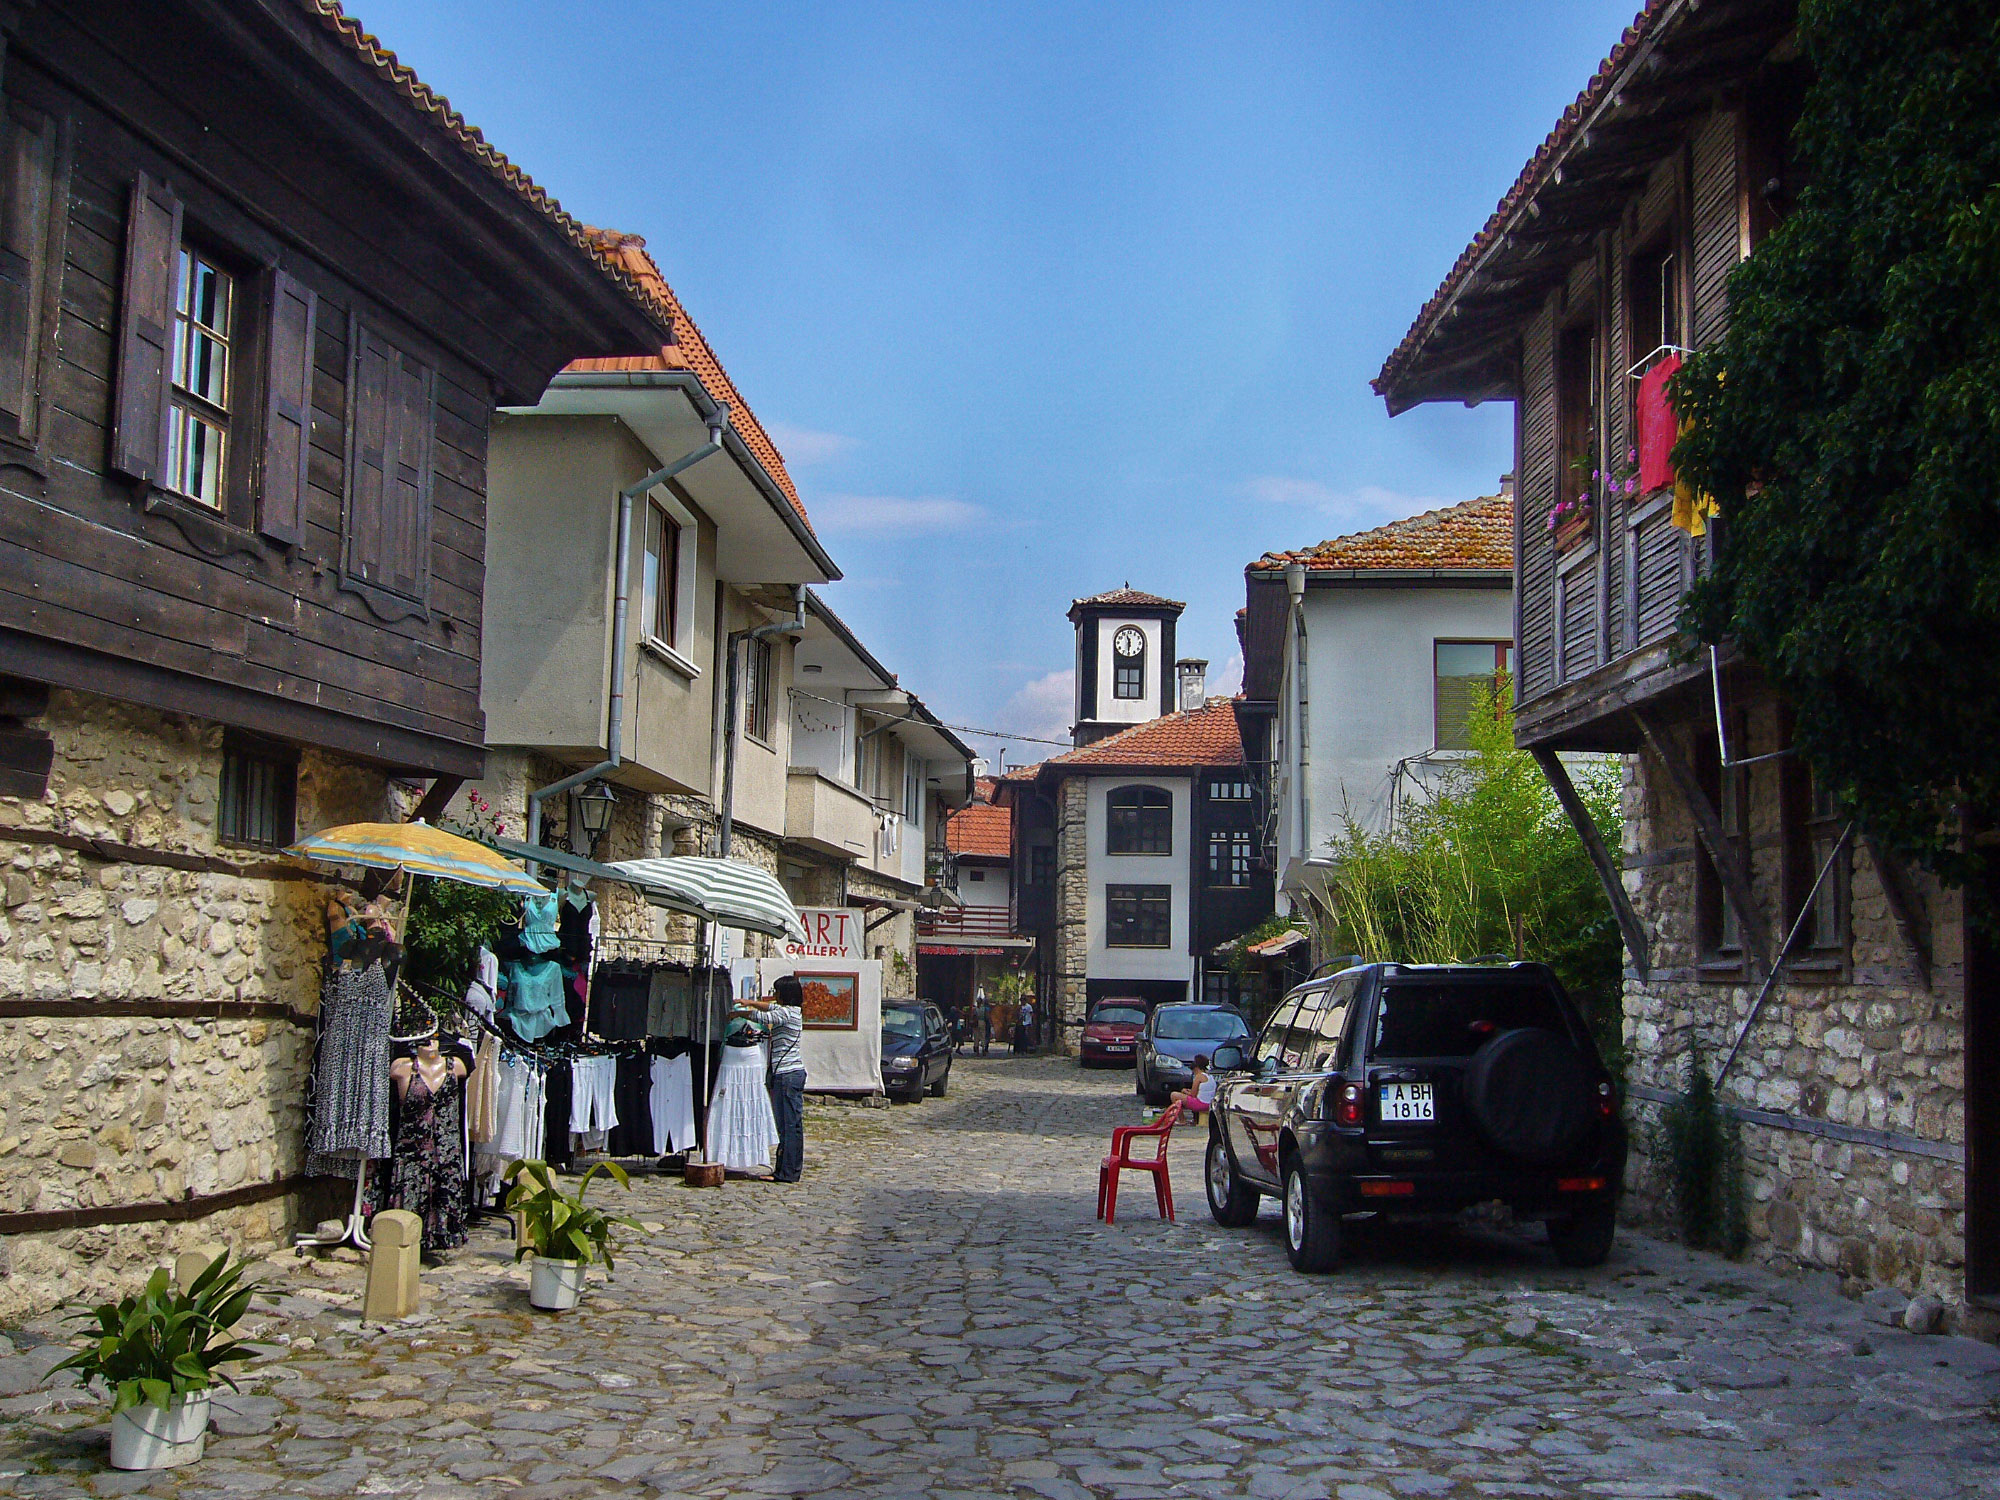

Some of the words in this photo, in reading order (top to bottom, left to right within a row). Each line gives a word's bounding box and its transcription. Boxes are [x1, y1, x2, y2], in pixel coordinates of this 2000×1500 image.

[800, 912, 850, 945] ART
[785, 944, 849, 957] GALLERY
[1395, 1085, 1404, 1100] A
[1411, 1085, 1431, 1100] BH
[1392, 1102, 1432, 1118] 1816
